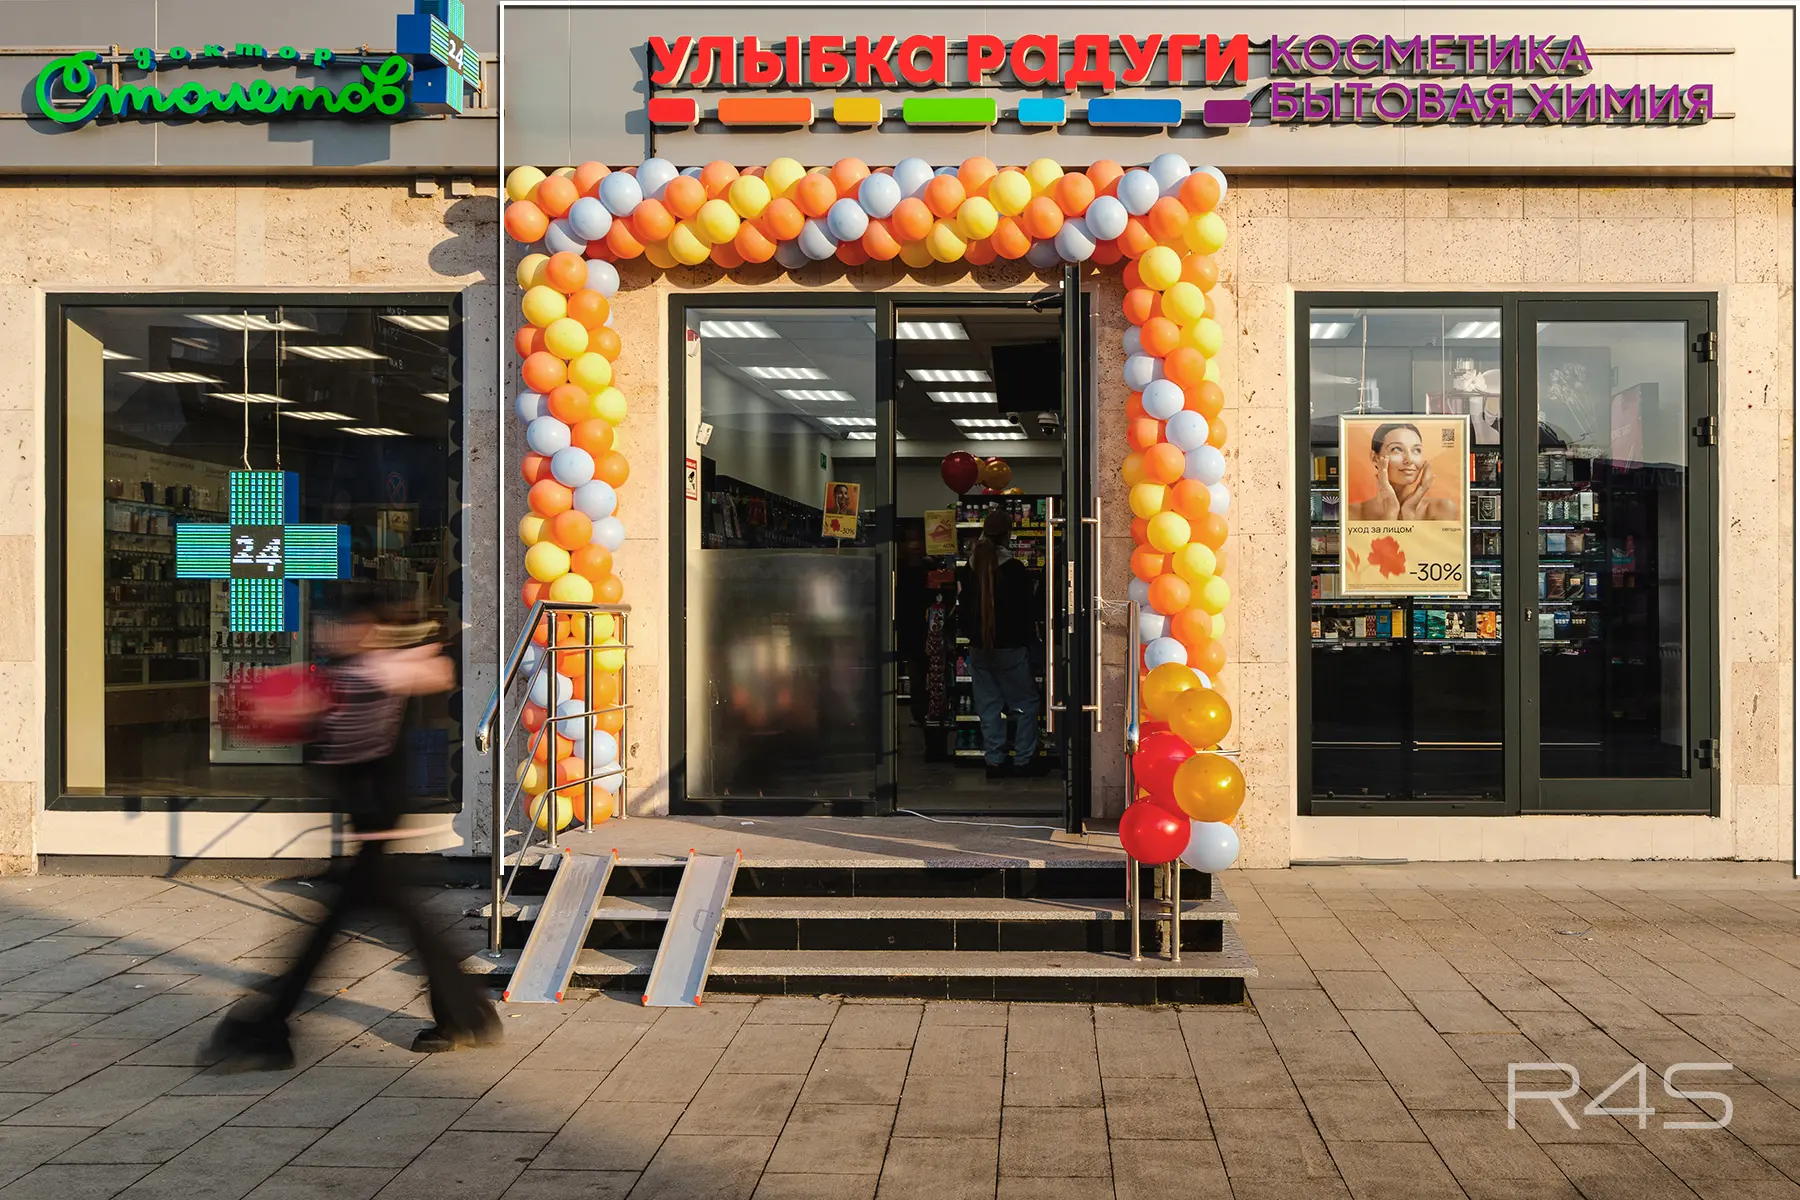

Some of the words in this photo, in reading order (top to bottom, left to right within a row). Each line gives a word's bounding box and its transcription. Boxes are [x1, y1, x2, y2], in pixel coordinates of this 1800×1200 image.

[448, 39, 464, 70] 24
[1271, 34, 1592, 71] КОСМЕТИКА
[35, 47, 408, 123] Столетов
[1271, 83, 1514, 119] БЫТОВАЯ
[1531, 84, 1713, 119] ХИМИЯ
[1347, 526, 1369, 535] уход
[1409, 562, 1462, 582] -30%
